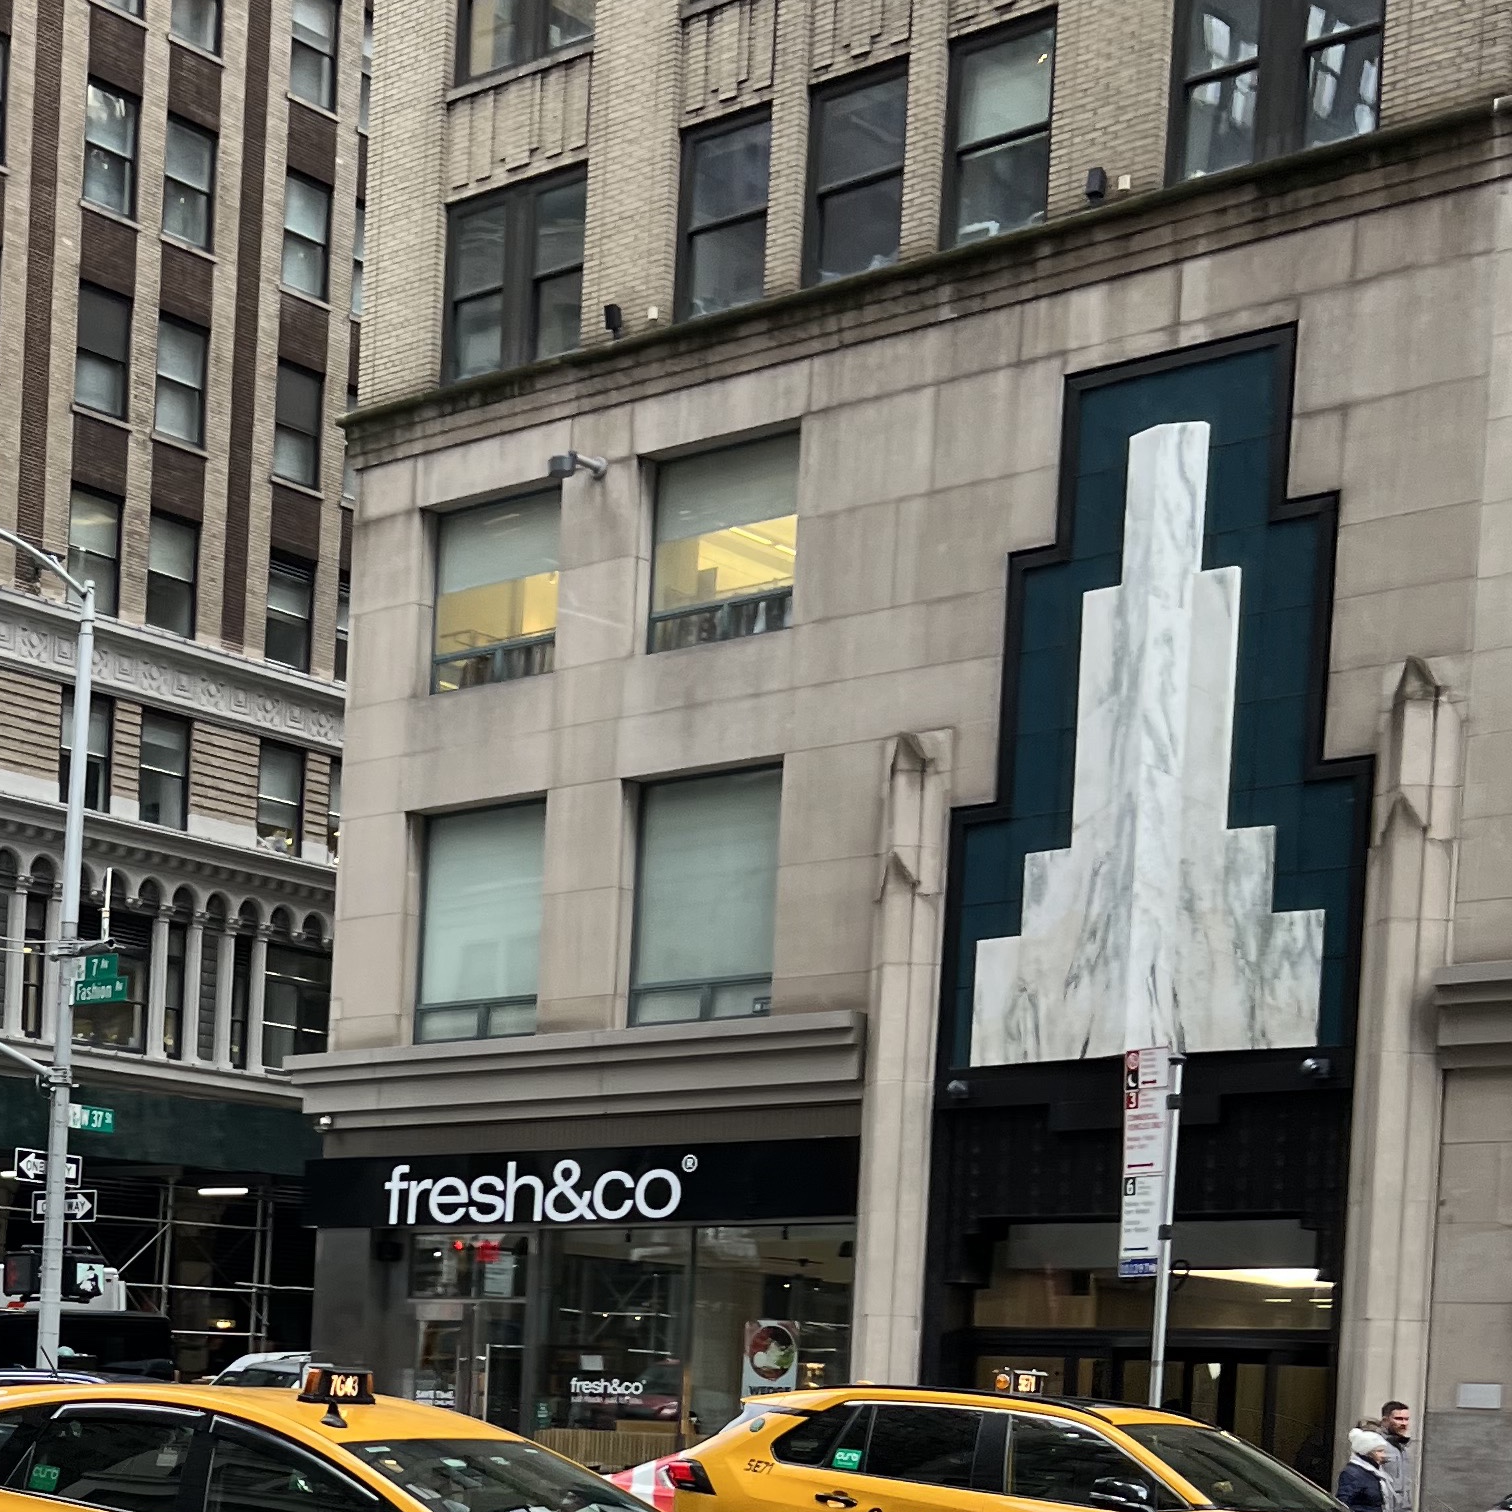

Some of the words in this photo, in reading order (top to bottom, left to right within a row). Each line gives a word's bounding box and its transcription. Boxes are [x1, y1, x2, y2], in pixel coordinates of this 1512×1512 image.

[91, 958, 98, 977] 7
[76, 982, 112, 1001] Fashion
[81, 1108, 90, 1126] W
[91, 1110, 104, 1128] 37
[330, 1374, 359, 1397] 7G43
[33, 1466, 59, 1480] curb
